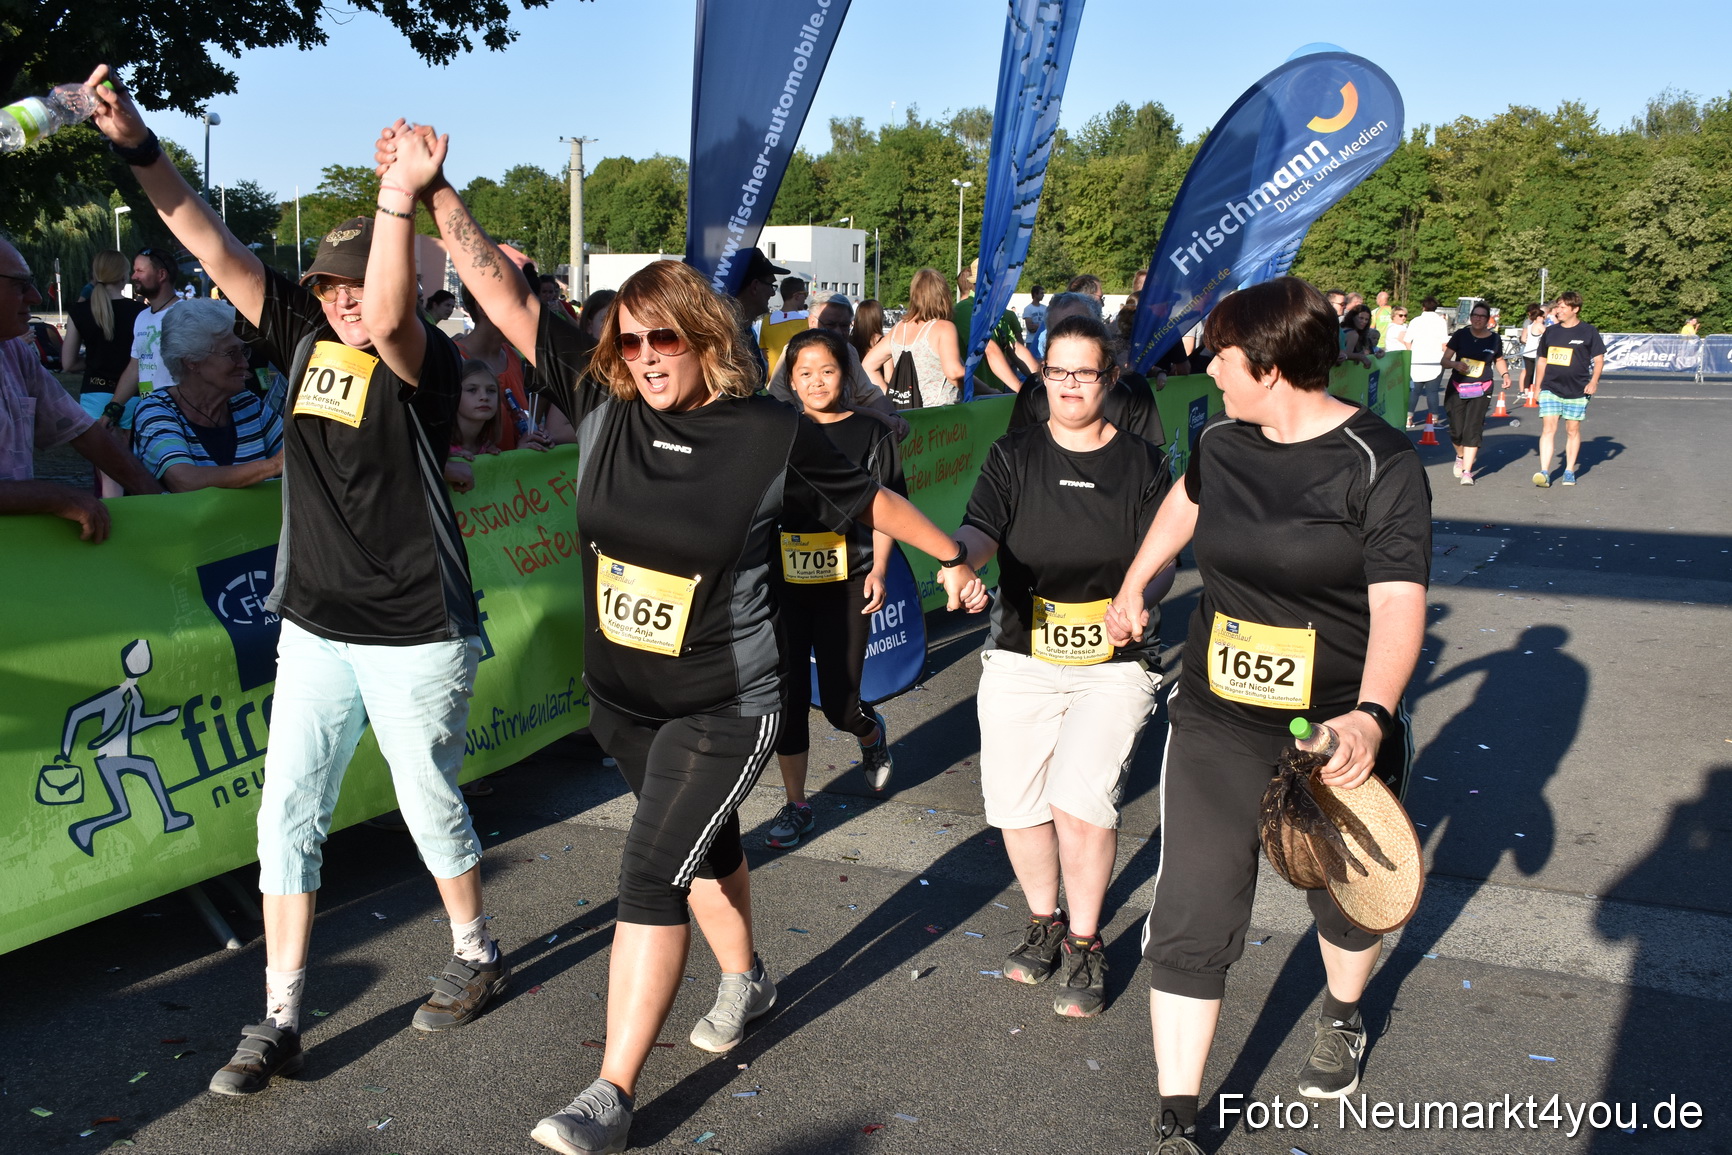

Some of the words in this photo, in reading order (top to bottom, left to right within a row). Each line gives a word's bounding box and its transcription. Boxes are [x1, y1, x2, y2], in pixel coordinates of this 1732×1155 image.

[1274, 177, 1315, 213] Druck
[1314, 156, 1342, 182] und
[1339, 118, 1388, 160] Medien
[1169, 139, 1330, 276] Frischmann
[1550, 352, 1568, 361] 1070
[1616, 349, 1677, 363] Fischer
[312, 394, 341, 407] Kerstin
[324, 404, 356, 418] Lauterhofen
[928, 423, 968, 452] Firmen
[935, 442, 975, 485] länger!
[455, 479, 549, 538] esunde
[789, 550, 838, 569] 1705
[603, 588, 674, 631] 1665
[608, 618, 633, 634] Krieger
[634, 627, 653, 637] Anja
[1040, 623, 1102, 648] 1653
[621, 631, 641, 642] Stiftung
[642, 636, 675, 648] Lauterhofen
[1046, 645, 1068, 654] Gruber
[1218, 647, 1295, 687] 1652
[1224, 685, 1244, 695] Wagner
[1244, 688, 1267, 699] Stiftung
[1267, 693, 1303, 702] Lauterhofen
[1229, 679, 1247, 689] Graf
[1248, 682, 1275, 694] Nicole
